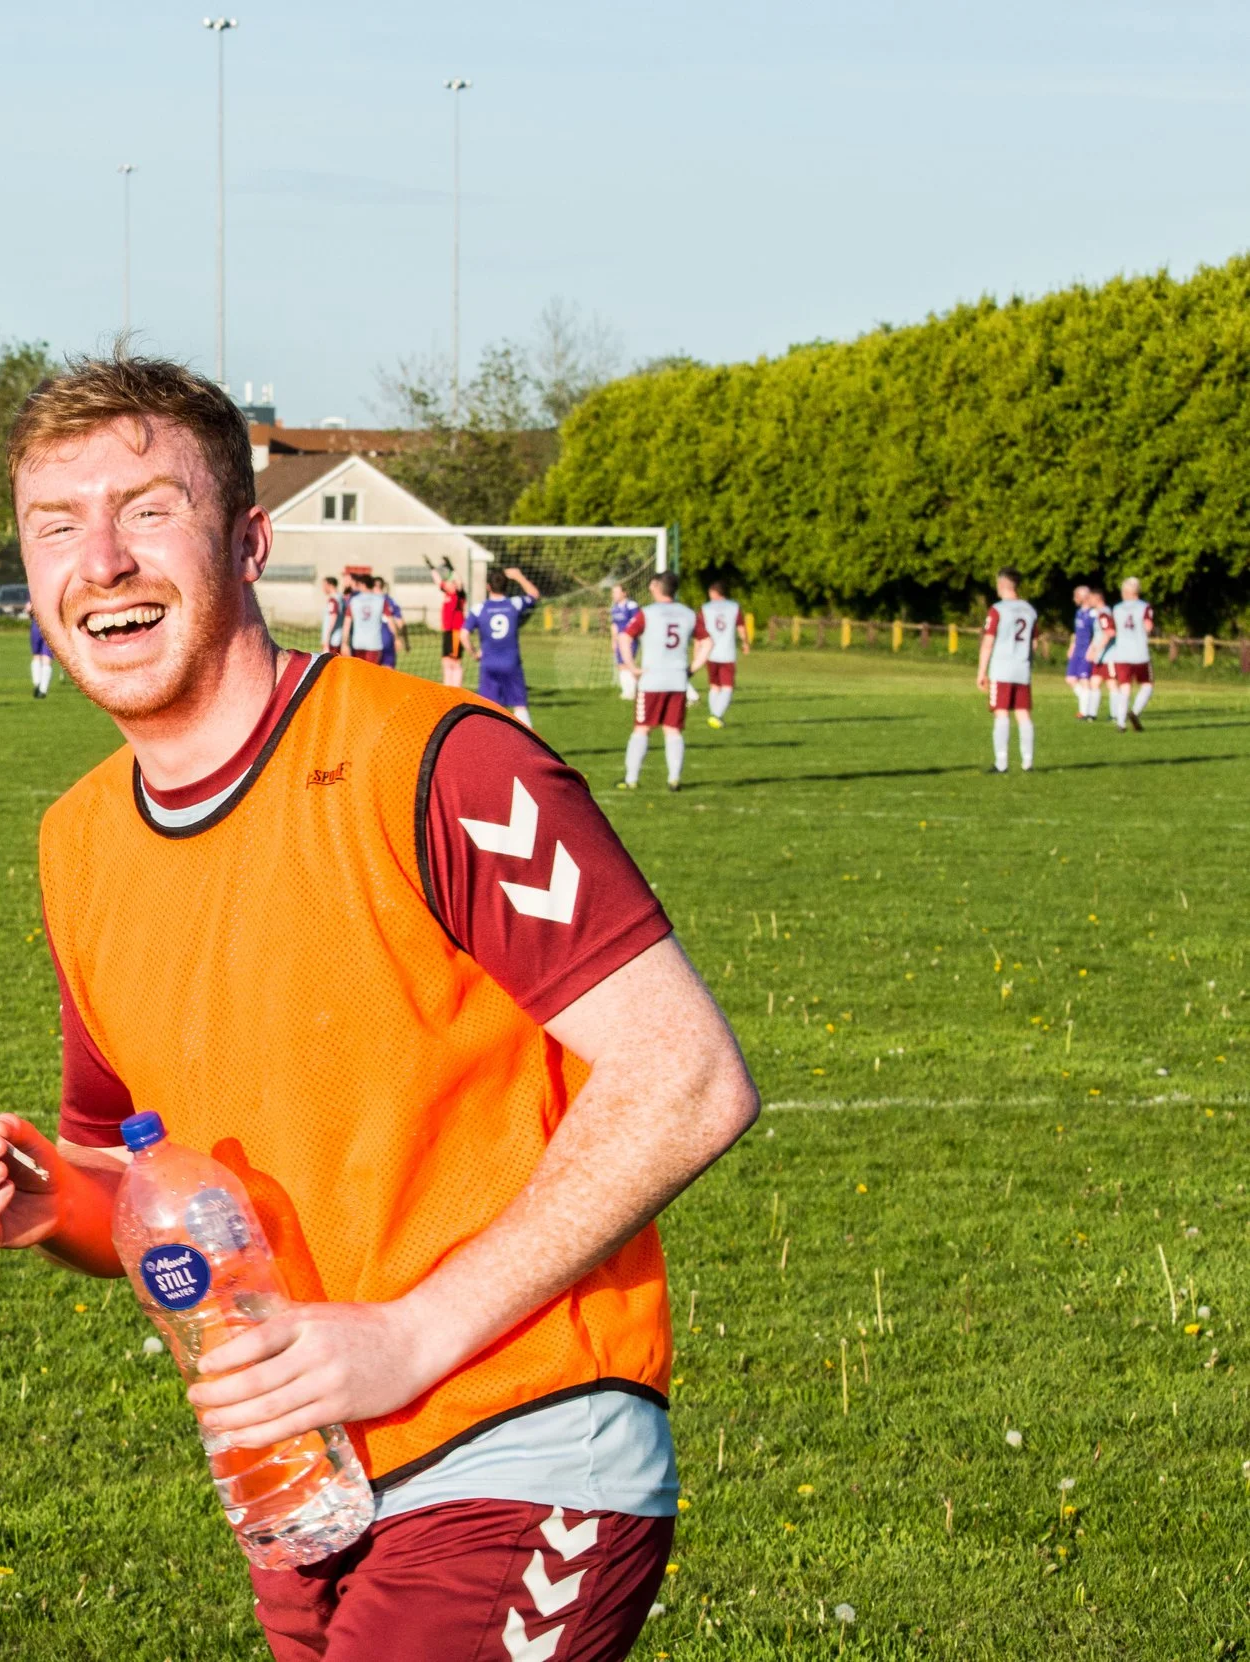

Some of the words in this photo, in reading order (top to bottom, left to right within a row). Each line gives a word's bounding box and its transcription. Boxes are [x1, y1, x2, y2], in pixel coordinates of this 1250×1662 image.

[490, 613, 510, 640] 9
[715, 615, 727, 632] 6
[1014, 618, 1027, 641] 2
[1124, 614, 1135, 631] 4
[665, 624, 680, 649] 5
[155, 1267, 198, 1292] STILL
[165, 1286, 197, 1300] WATER
